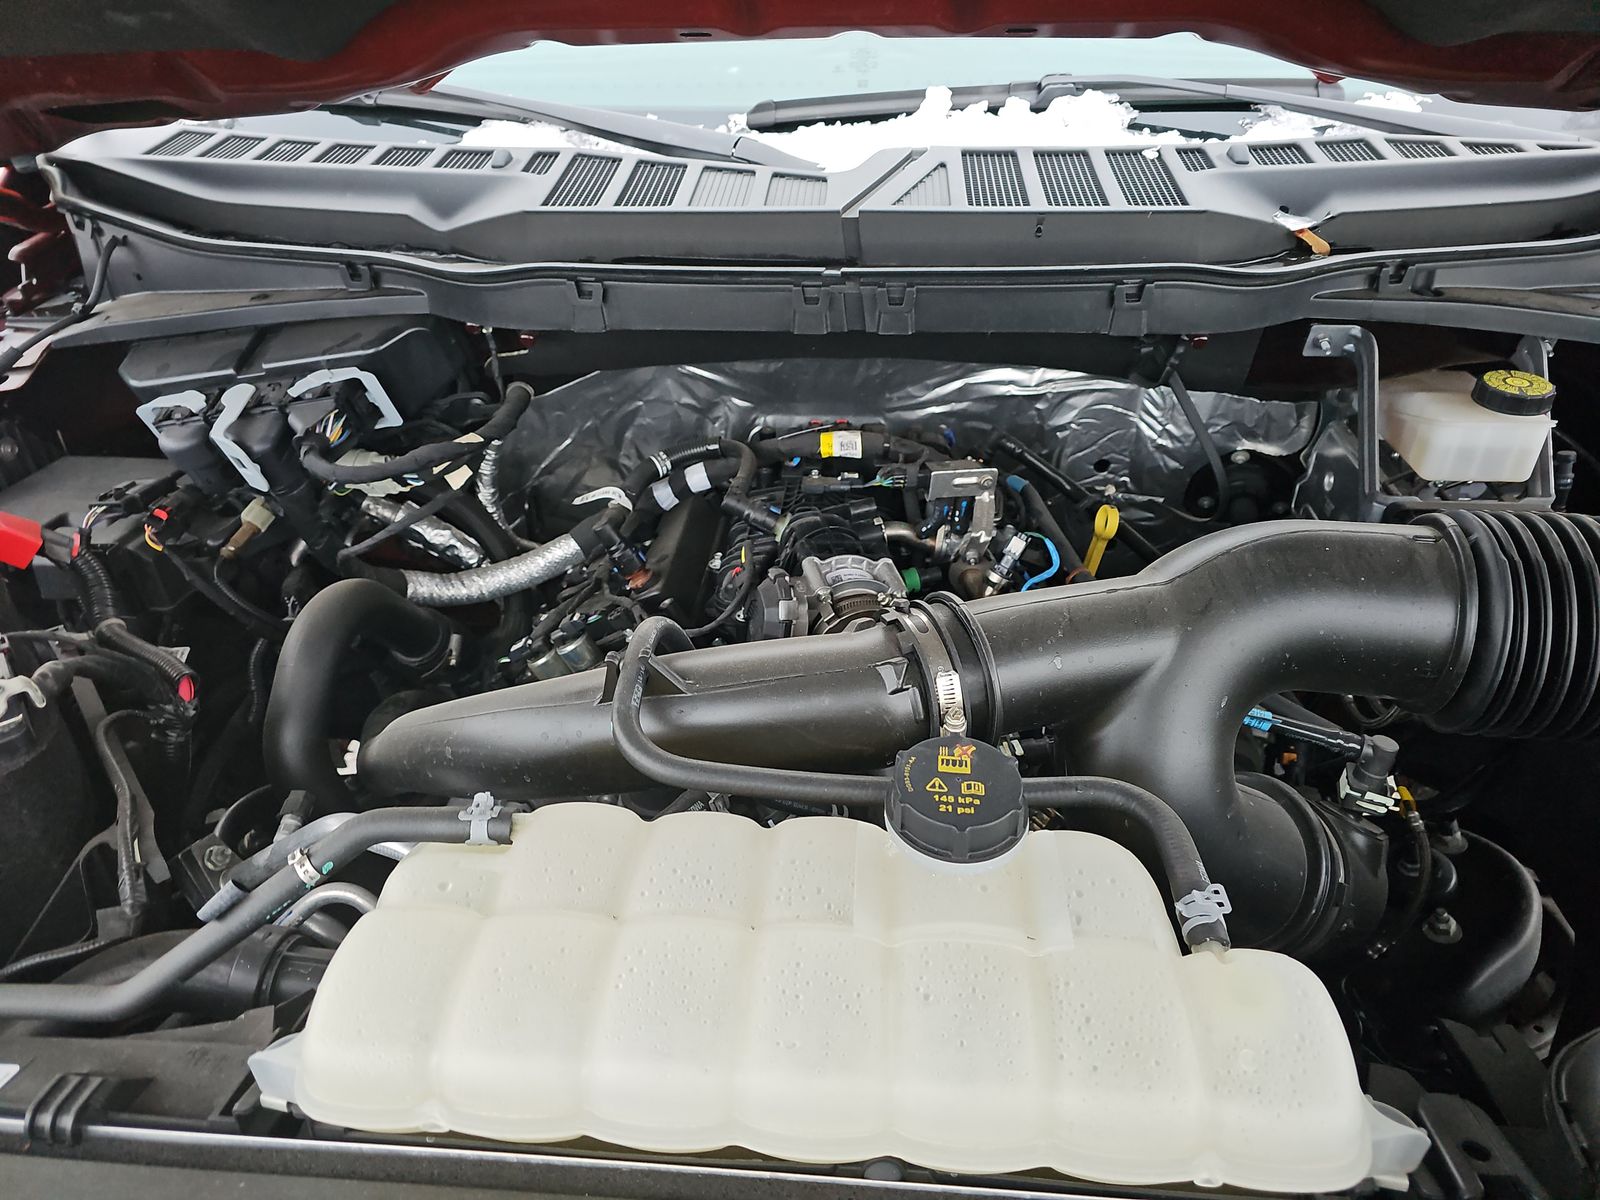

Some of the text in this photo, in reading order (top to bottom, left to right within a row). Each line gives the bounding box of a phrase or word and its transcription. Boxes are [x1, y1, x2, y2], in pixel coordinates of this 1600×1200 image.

[958, 796, 981, 805] kPa
[938, 804, 975, 815] 21 psi
